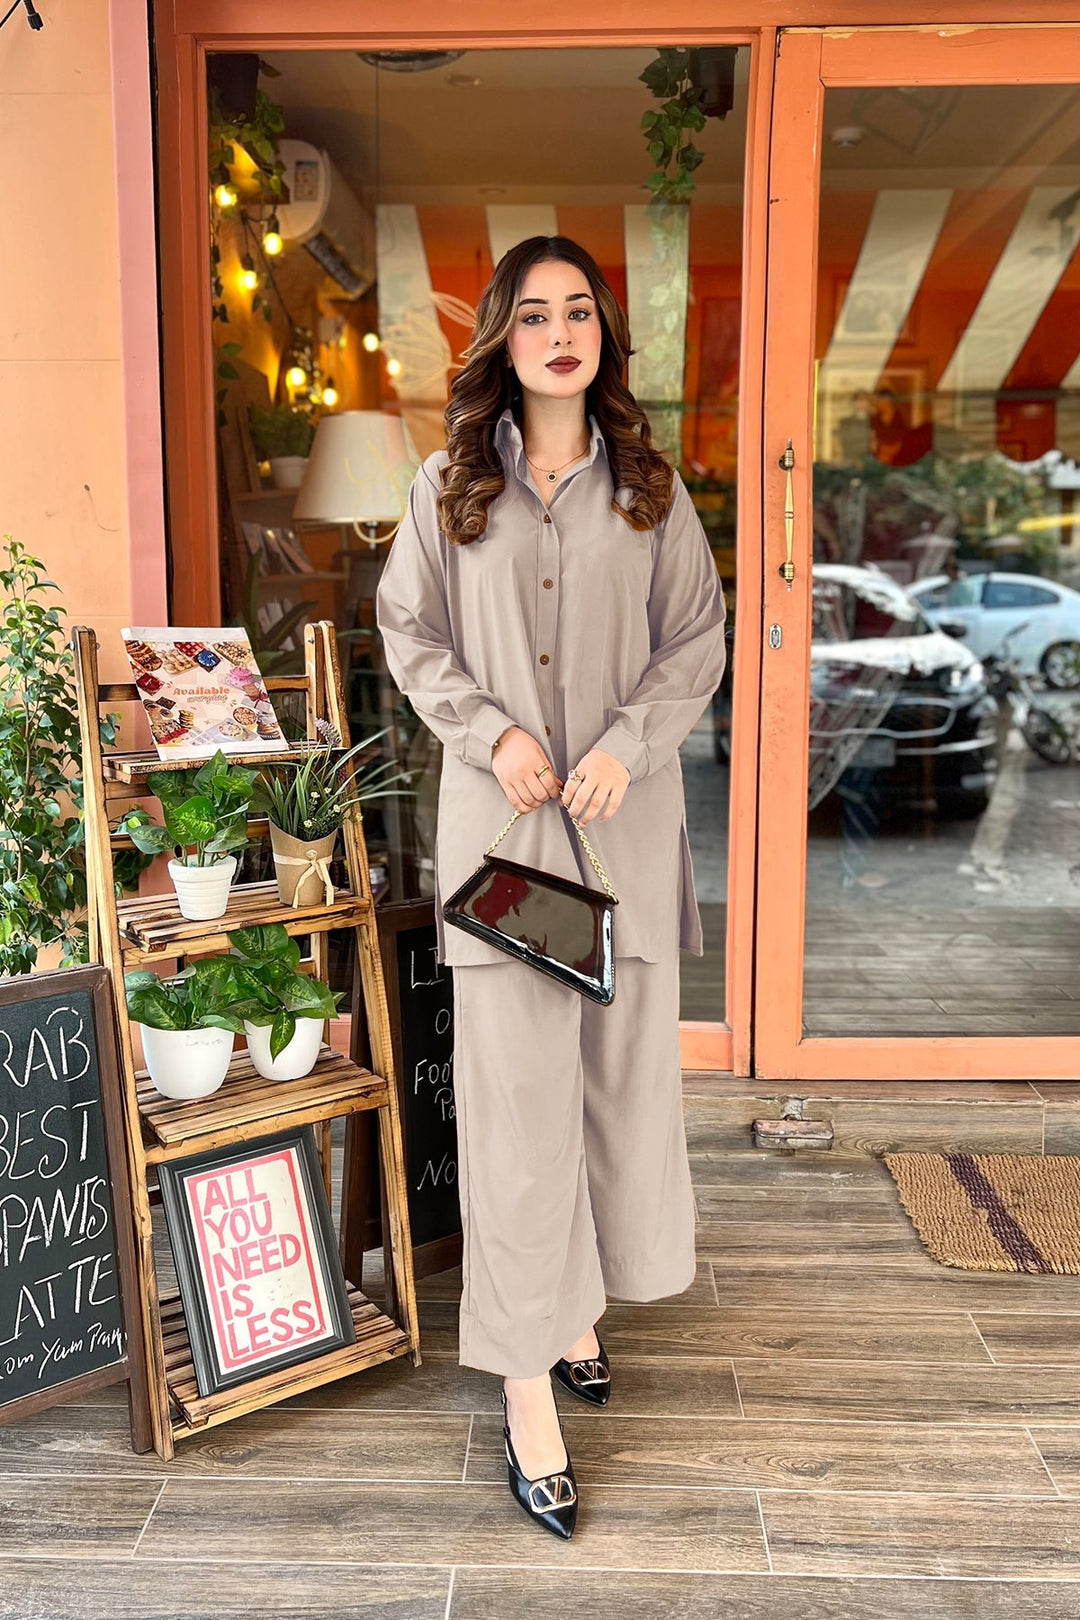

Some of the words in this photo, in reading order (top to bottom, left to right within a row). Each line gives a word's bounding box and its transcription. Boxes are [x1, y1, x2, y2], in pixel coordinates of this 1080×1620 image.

[173, 686, 230, 695] Available
[204, 1168, 268, 1216] ALL
[0, 1175, 109, 1267] PANIS
[204, 1201, 273, 1249] YOU
[212, 1233, 302, 1288] NEED
[220, 1284, 254, 1322] IS
[227, 1300, 316, 1358] LESS
